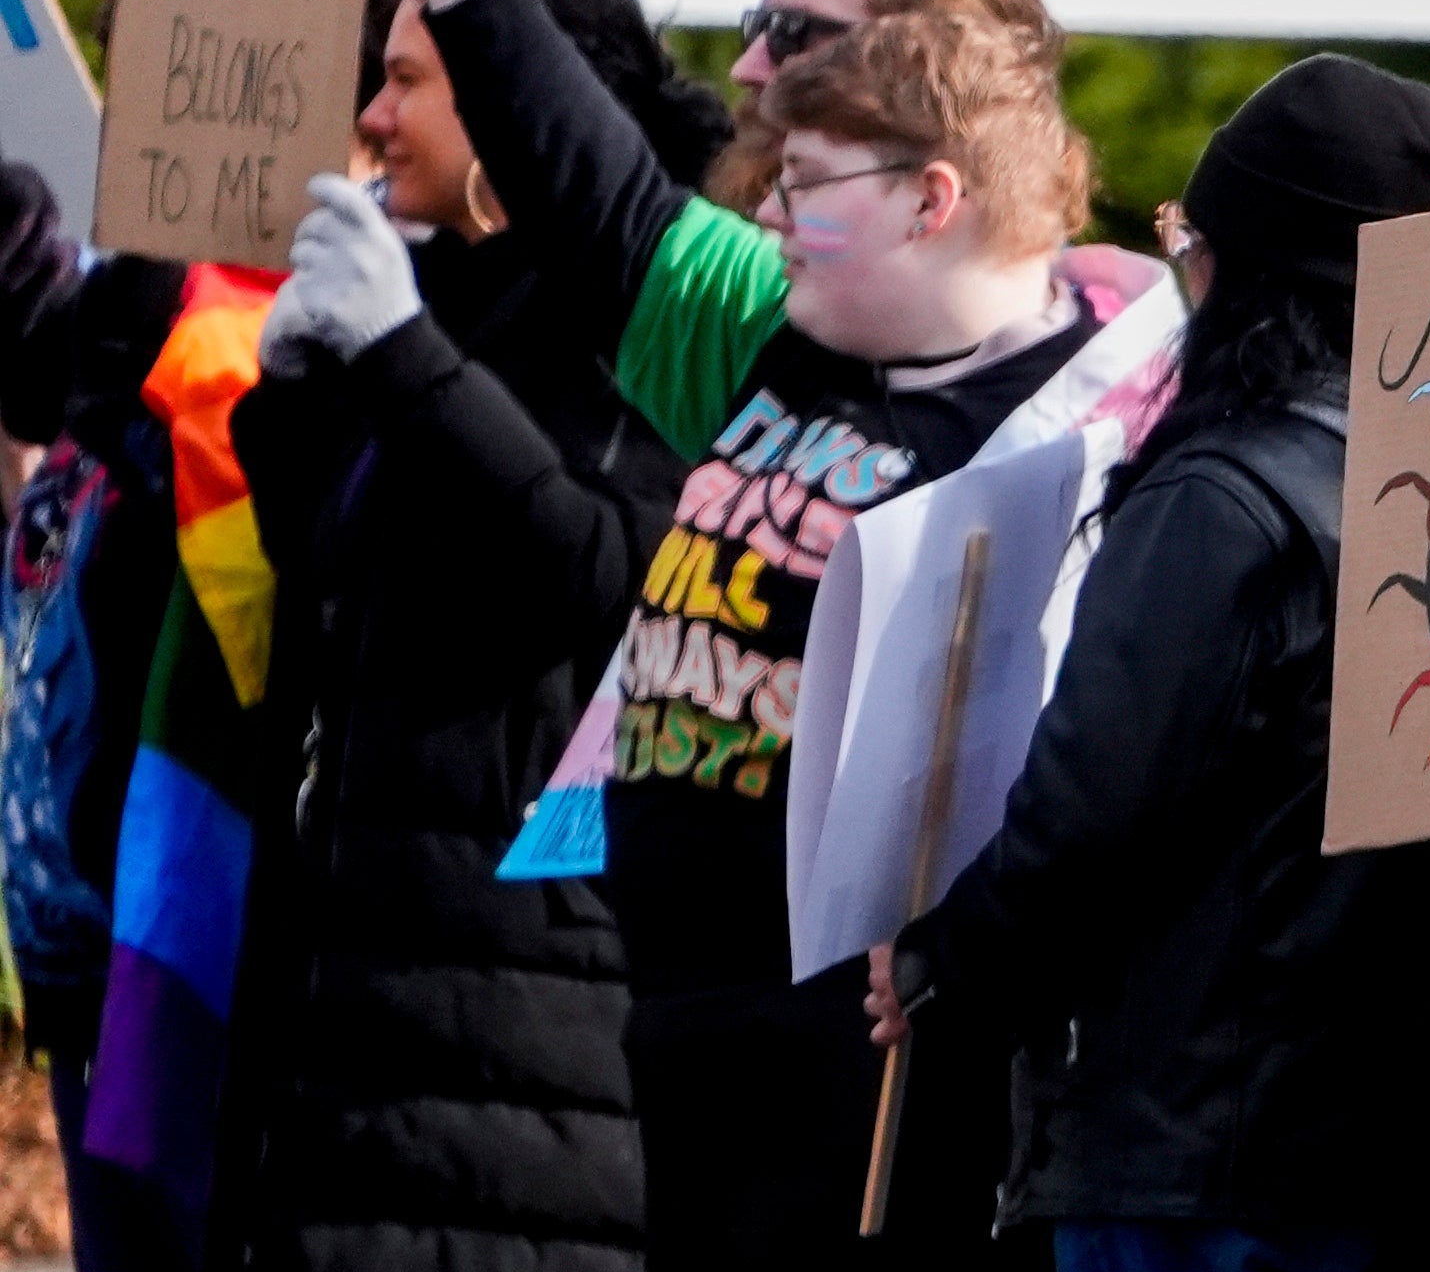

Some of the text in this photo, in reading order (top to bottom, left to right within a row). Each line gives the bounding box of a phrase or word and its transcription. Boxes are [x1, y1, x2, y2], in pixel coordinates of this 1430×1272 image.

[163, 13, 303, 145] BELONGS
[139, 146, 277, 244] TO ME
